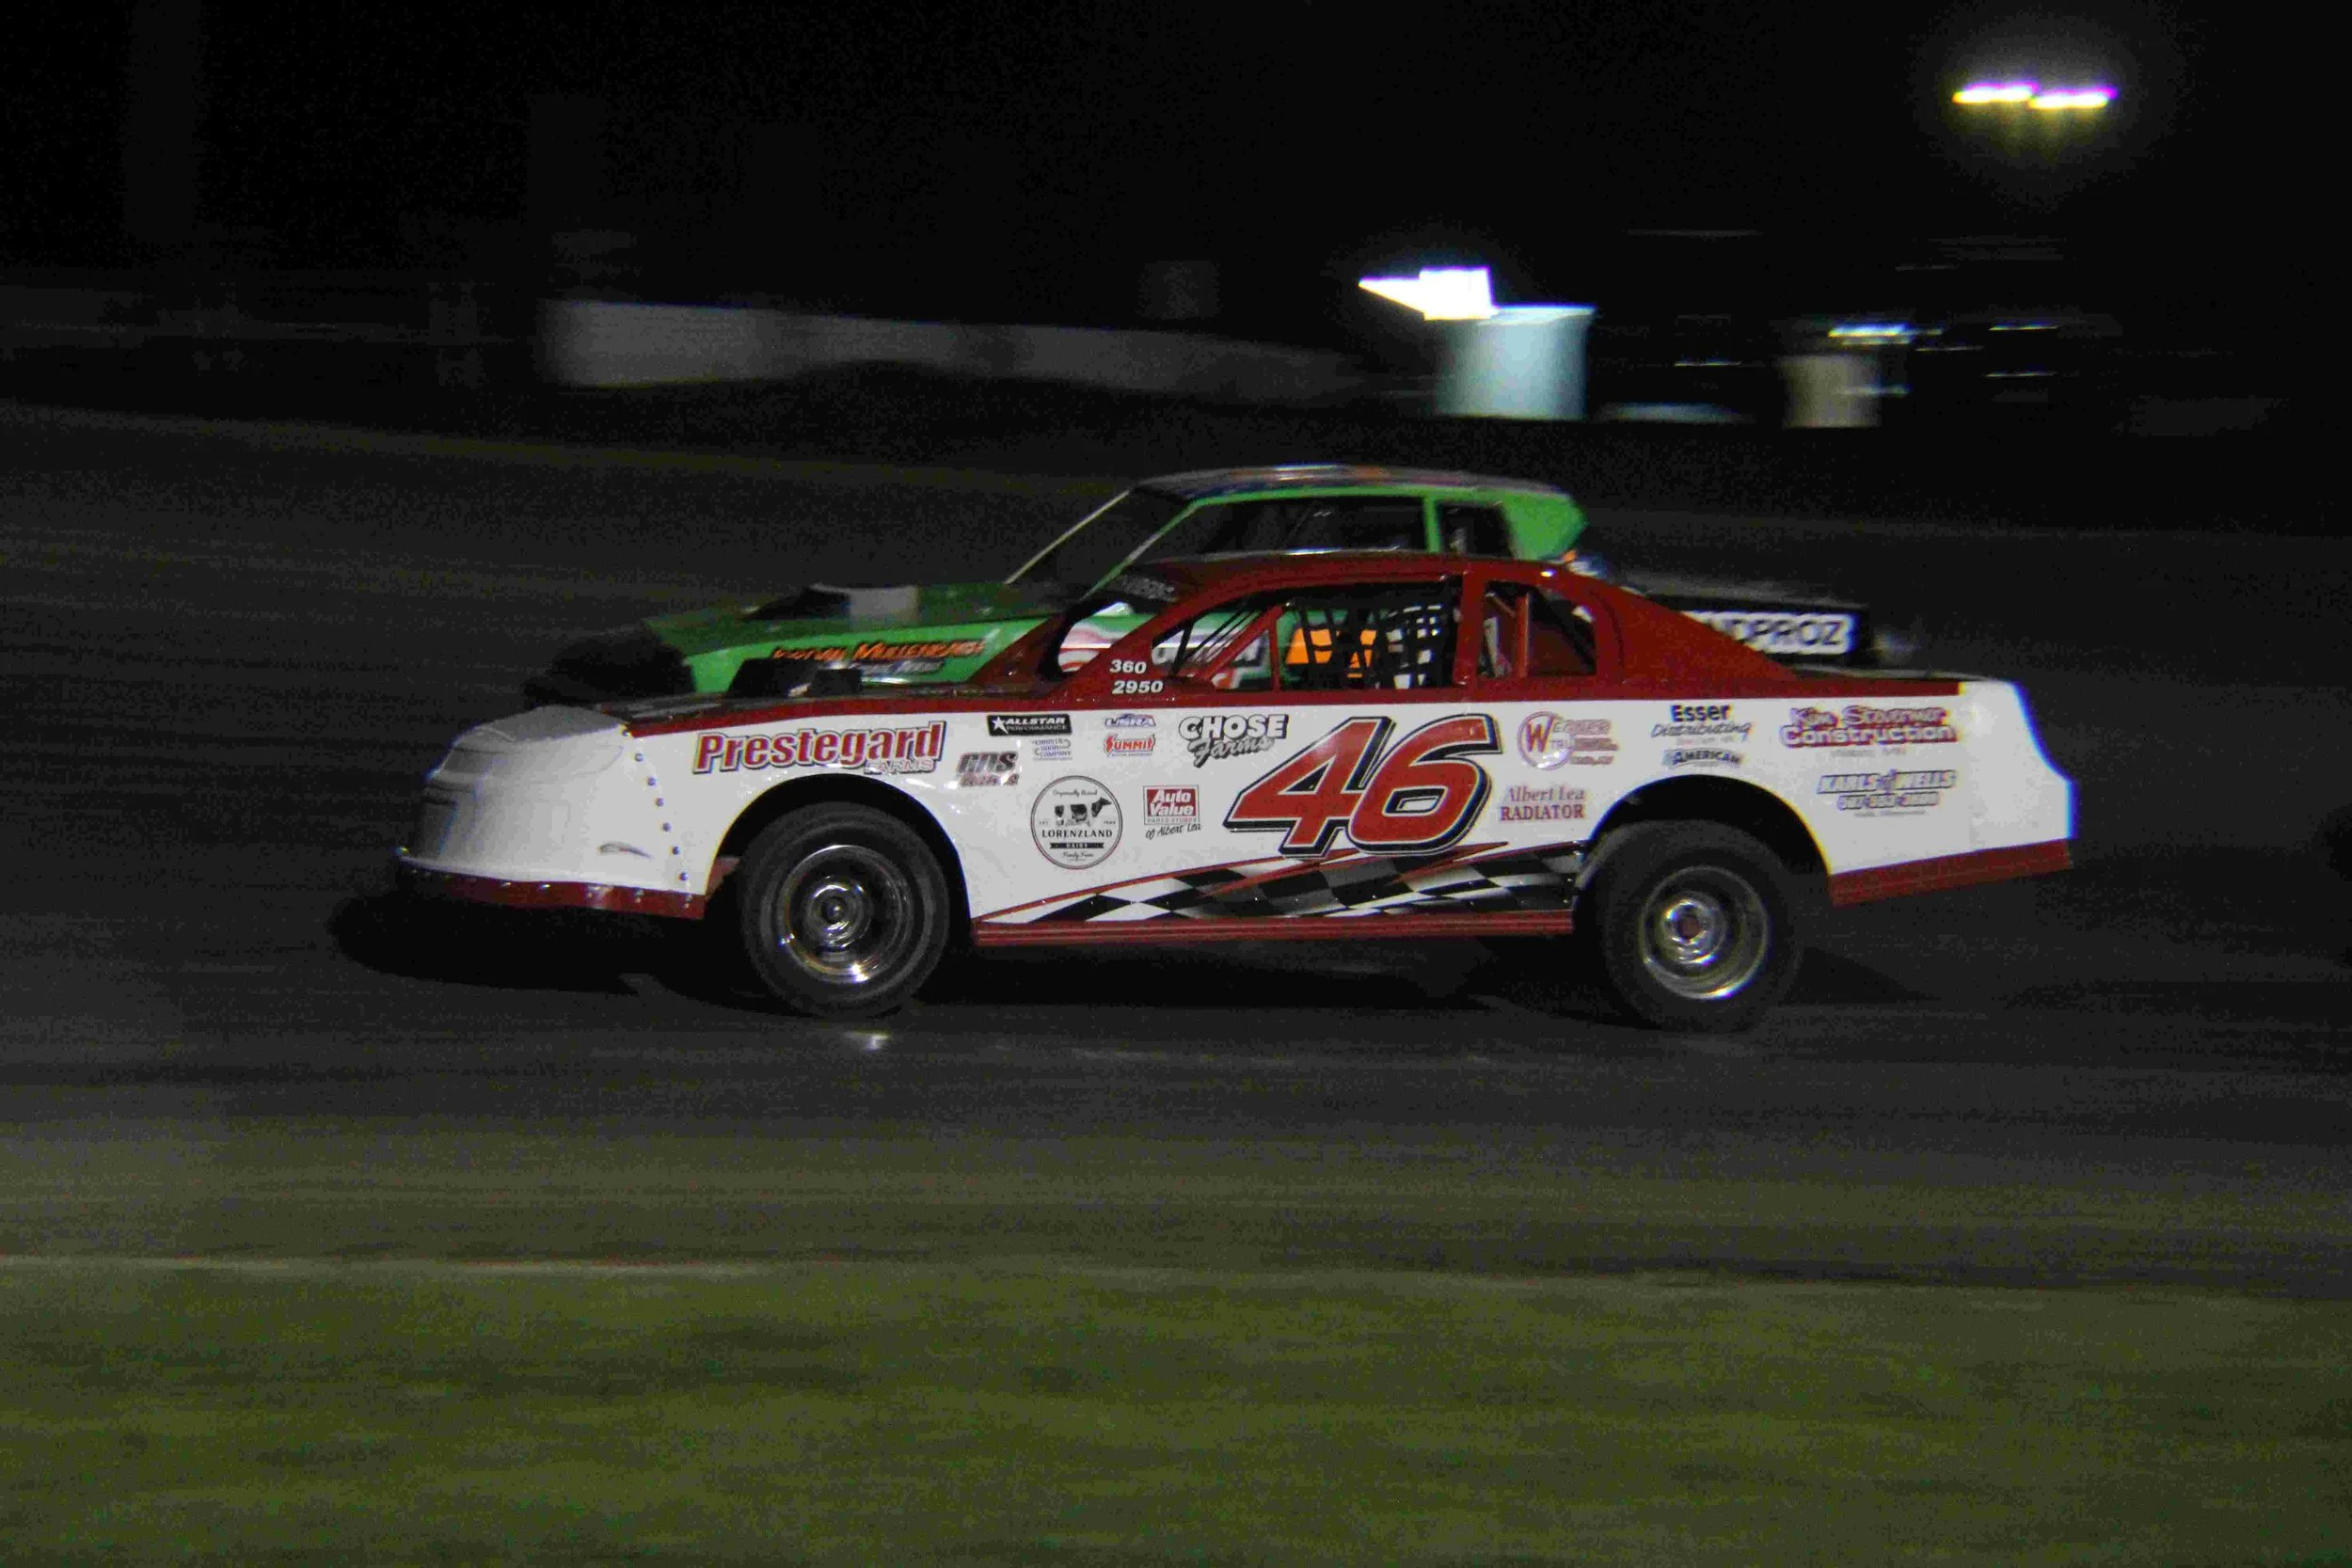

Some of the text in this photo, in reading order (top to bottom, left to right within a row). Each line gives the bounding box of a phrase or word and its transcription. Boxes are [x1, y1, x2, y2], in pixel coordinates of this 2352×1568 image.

[1110, 659, 1147, 674] 360
[1112, 680, 1163, 694] 2950
[1005, 717, 1066, 725] ALLSTAR
[1671, 705, 1730, 722] Esser
[1178, 714, 1289, 741] CHOSE
[1778, 724, 1958, 749] Construction
[692, 721, 946, 774] Prestegard
[1187, 737, 1276, 768] Farms
[1223, 712, 1502, 859] 46
[1507, 784, 1585, 802] Albert Lea
[1152, 789, 1192, 803] Auto
[1150, 801, 1195, 816] Value
[1500, 803, 1585, 821] RADIATOR
[1041, 829, 1113, 839] LORENZLAND
